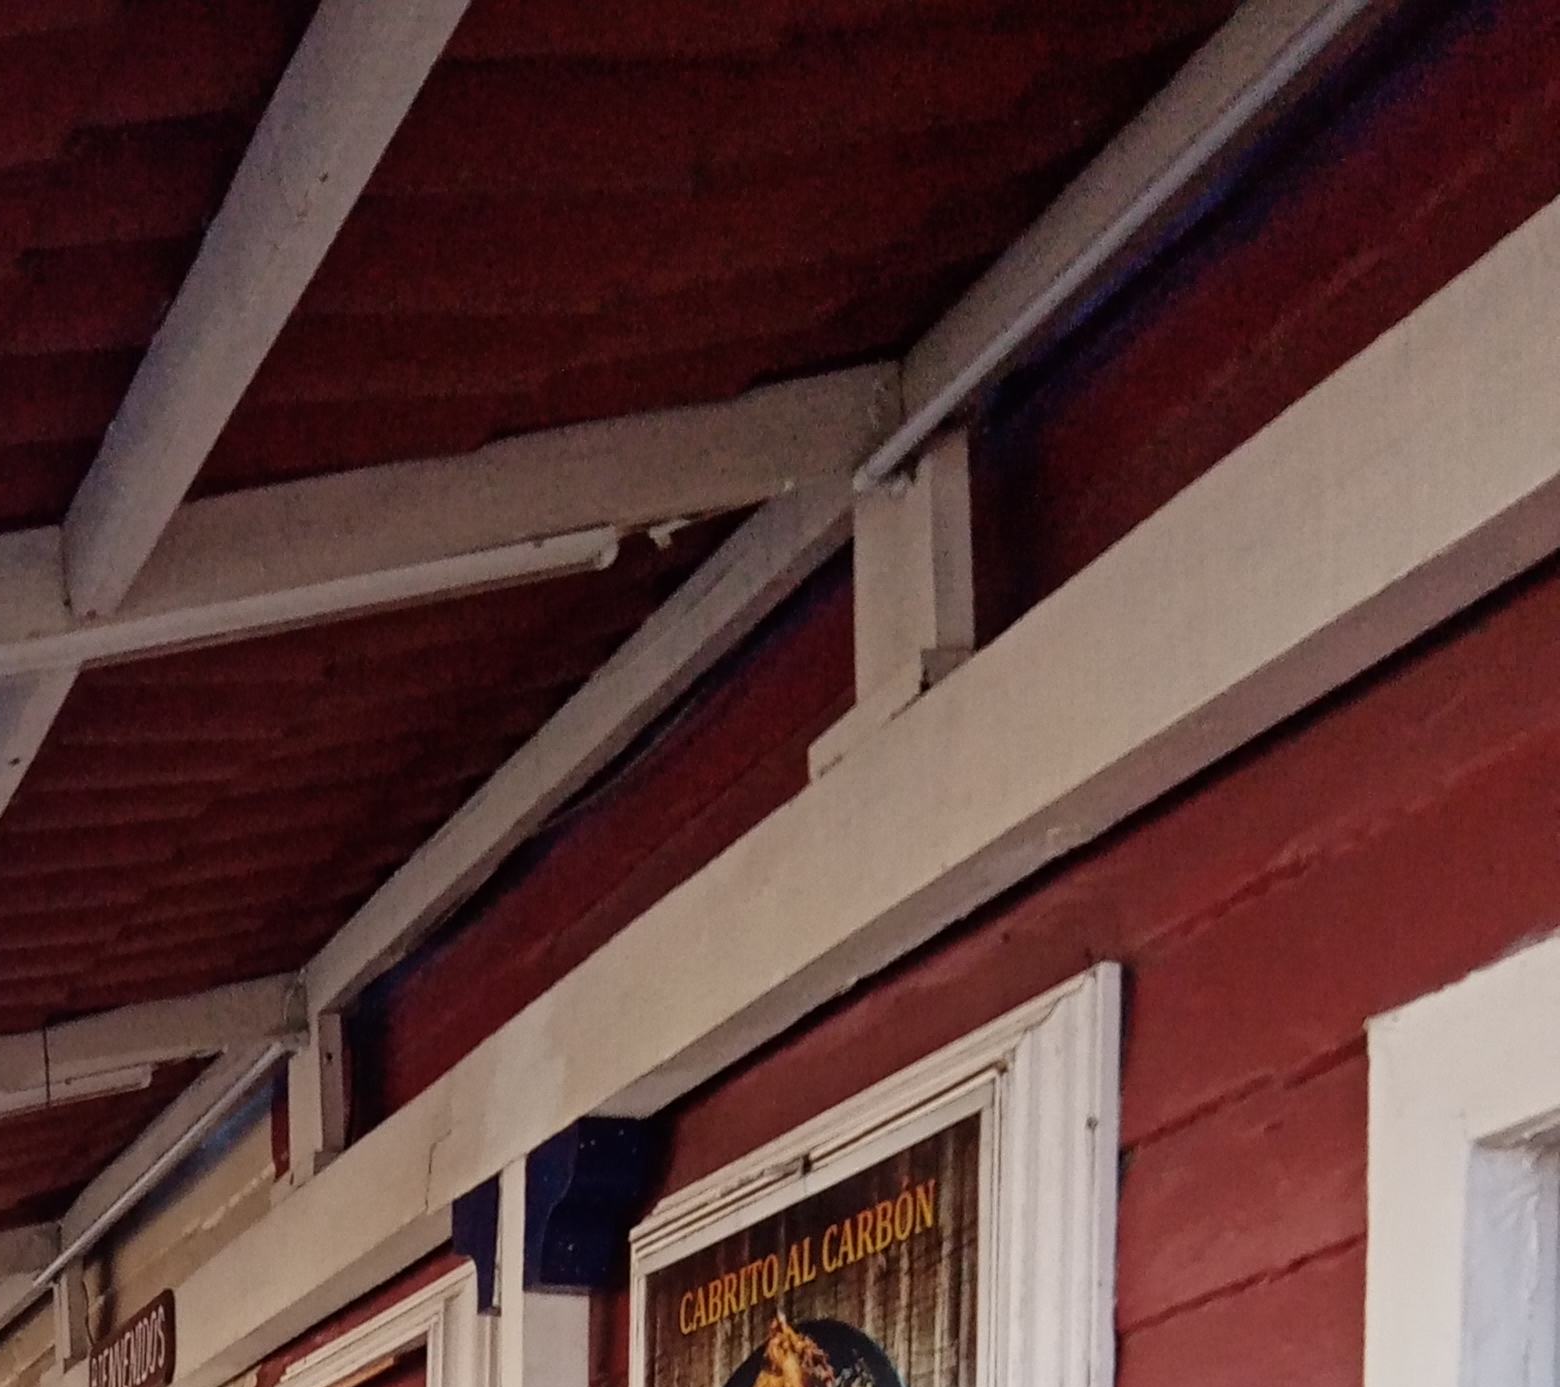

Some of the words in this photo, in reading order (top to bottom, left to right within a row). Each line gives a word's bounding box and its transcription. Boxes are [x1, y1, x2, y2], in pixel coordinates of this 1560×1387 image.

[679, 1253, 779, 1335] CABRITO
[783, 1236, 816, 1292] AL
[821, 1175, 935, 1274] CARBÓN
